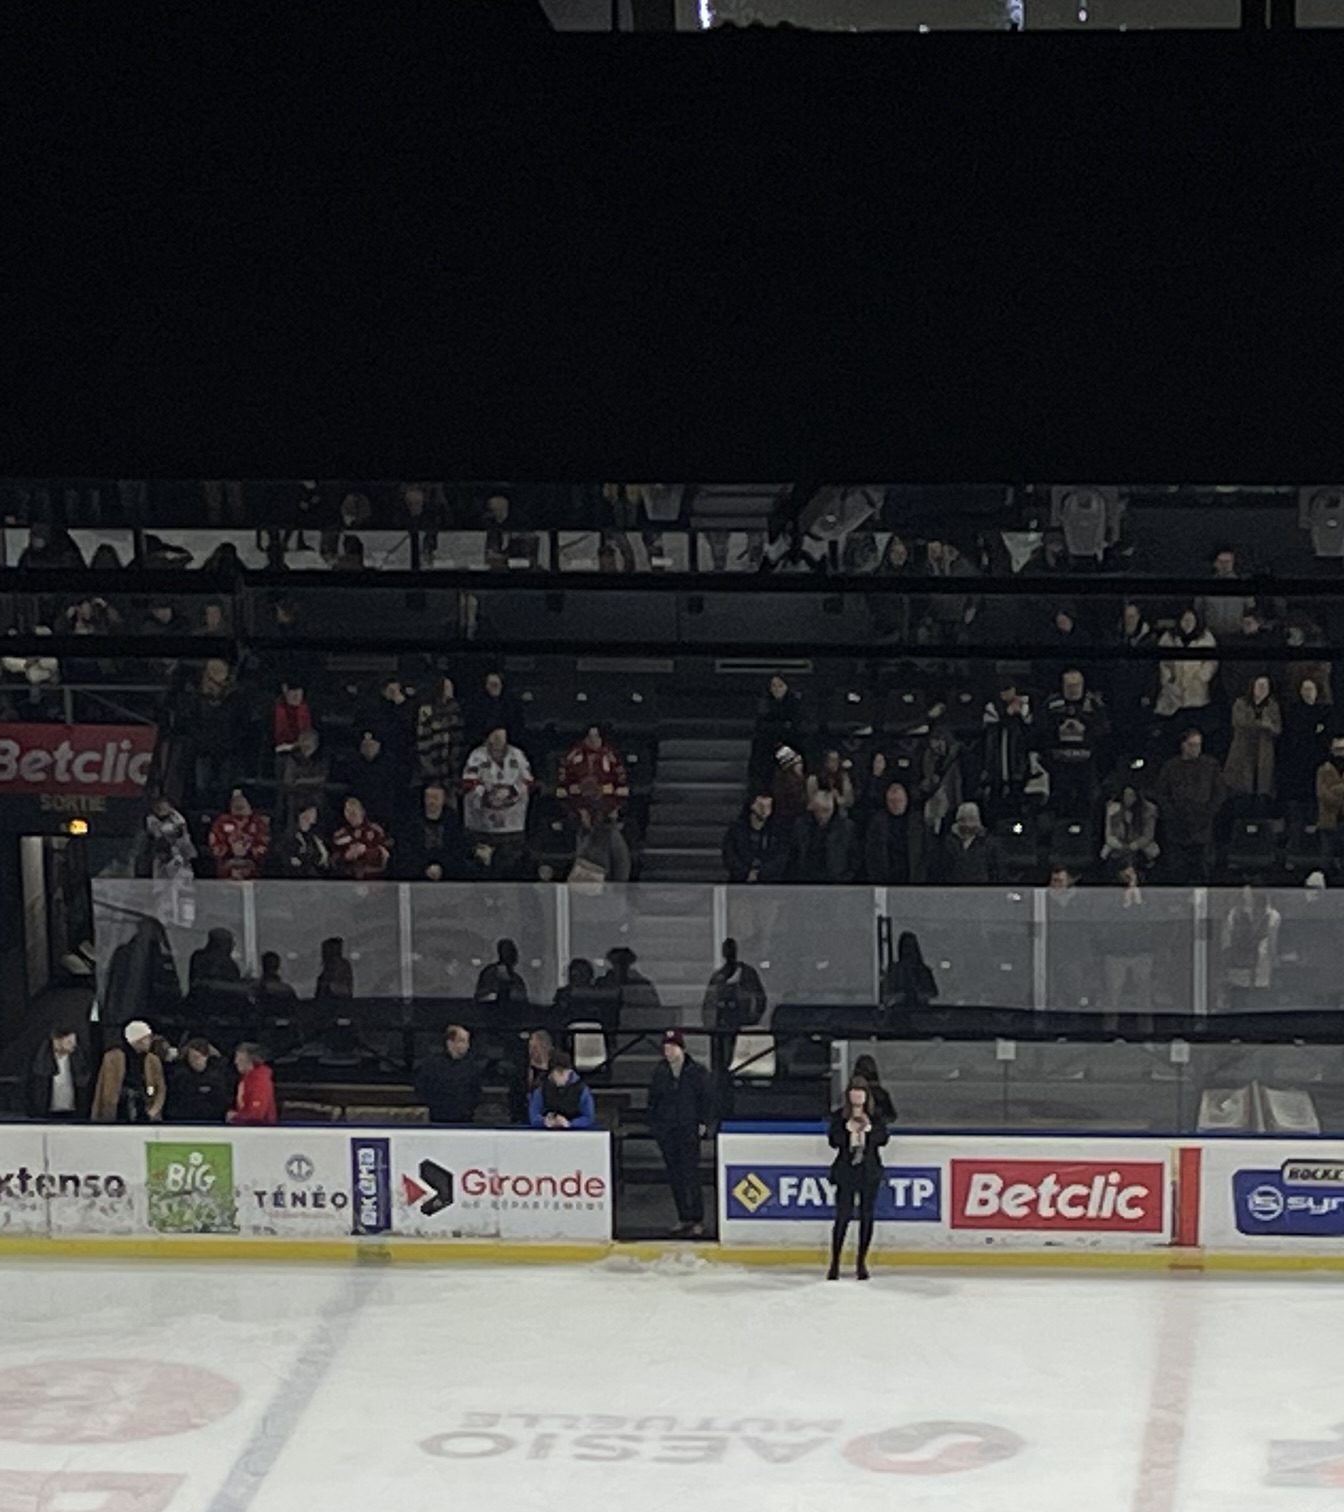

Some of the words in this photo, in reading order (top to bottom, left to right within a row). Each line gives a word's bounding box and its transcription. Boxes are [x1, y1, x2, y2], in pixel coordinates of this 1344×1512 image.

[40, 793, 106, 812] SORTIE
[253, 1184, 348, 1210] TÉNÉO
[461, 1167, 606, 1199] Gironde
[889, 1178, 936, 1208] TP
[964, 1171, 1150, 1220] Betclic
